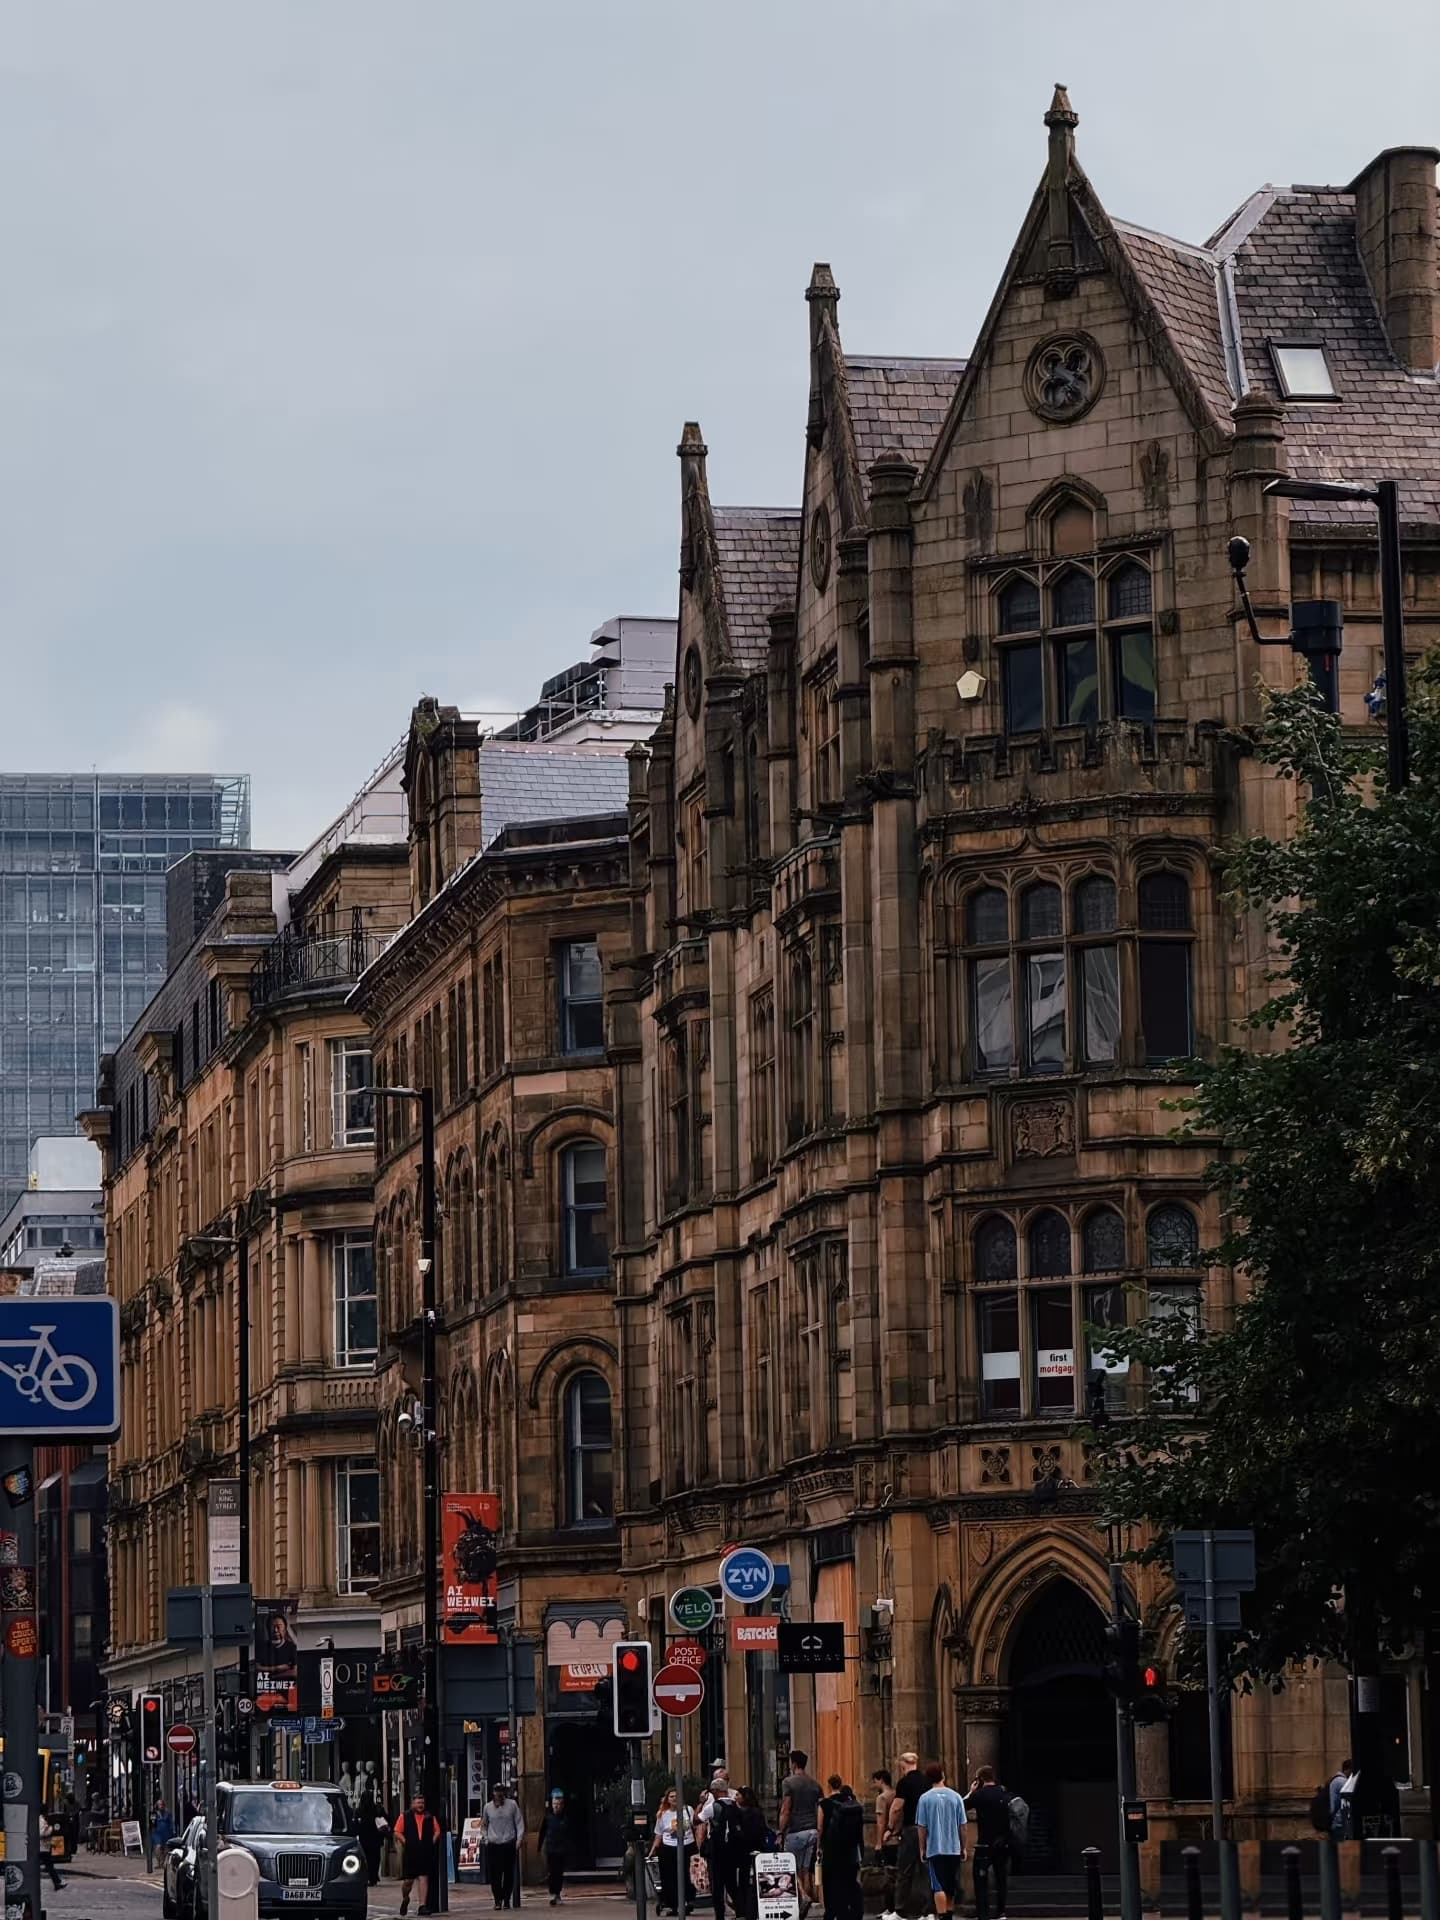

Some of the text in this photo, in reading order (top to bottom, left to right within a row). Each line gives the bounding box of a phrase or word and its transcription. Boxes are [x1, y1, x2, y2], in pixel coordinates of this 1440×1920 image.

[1050, 1353, 1067, 1362] first
[215, 1502, 237, 1510] STREET
[728, 1567, 767, 1583] ZYN
[447, 1586, 463, 1596] AI
[446, 1597, 495, 1607] WEIWEI
[675, 1602, 711, 1615] VELO
[674, 1647, 698, 1656] POST
[669, 1656, 702, 1665] OFFICE
[257, 1672, 270, 1681] AI
[256, 1681, 295, 1690] WEIWEI
[240, 1701, 252, 1710] 20
